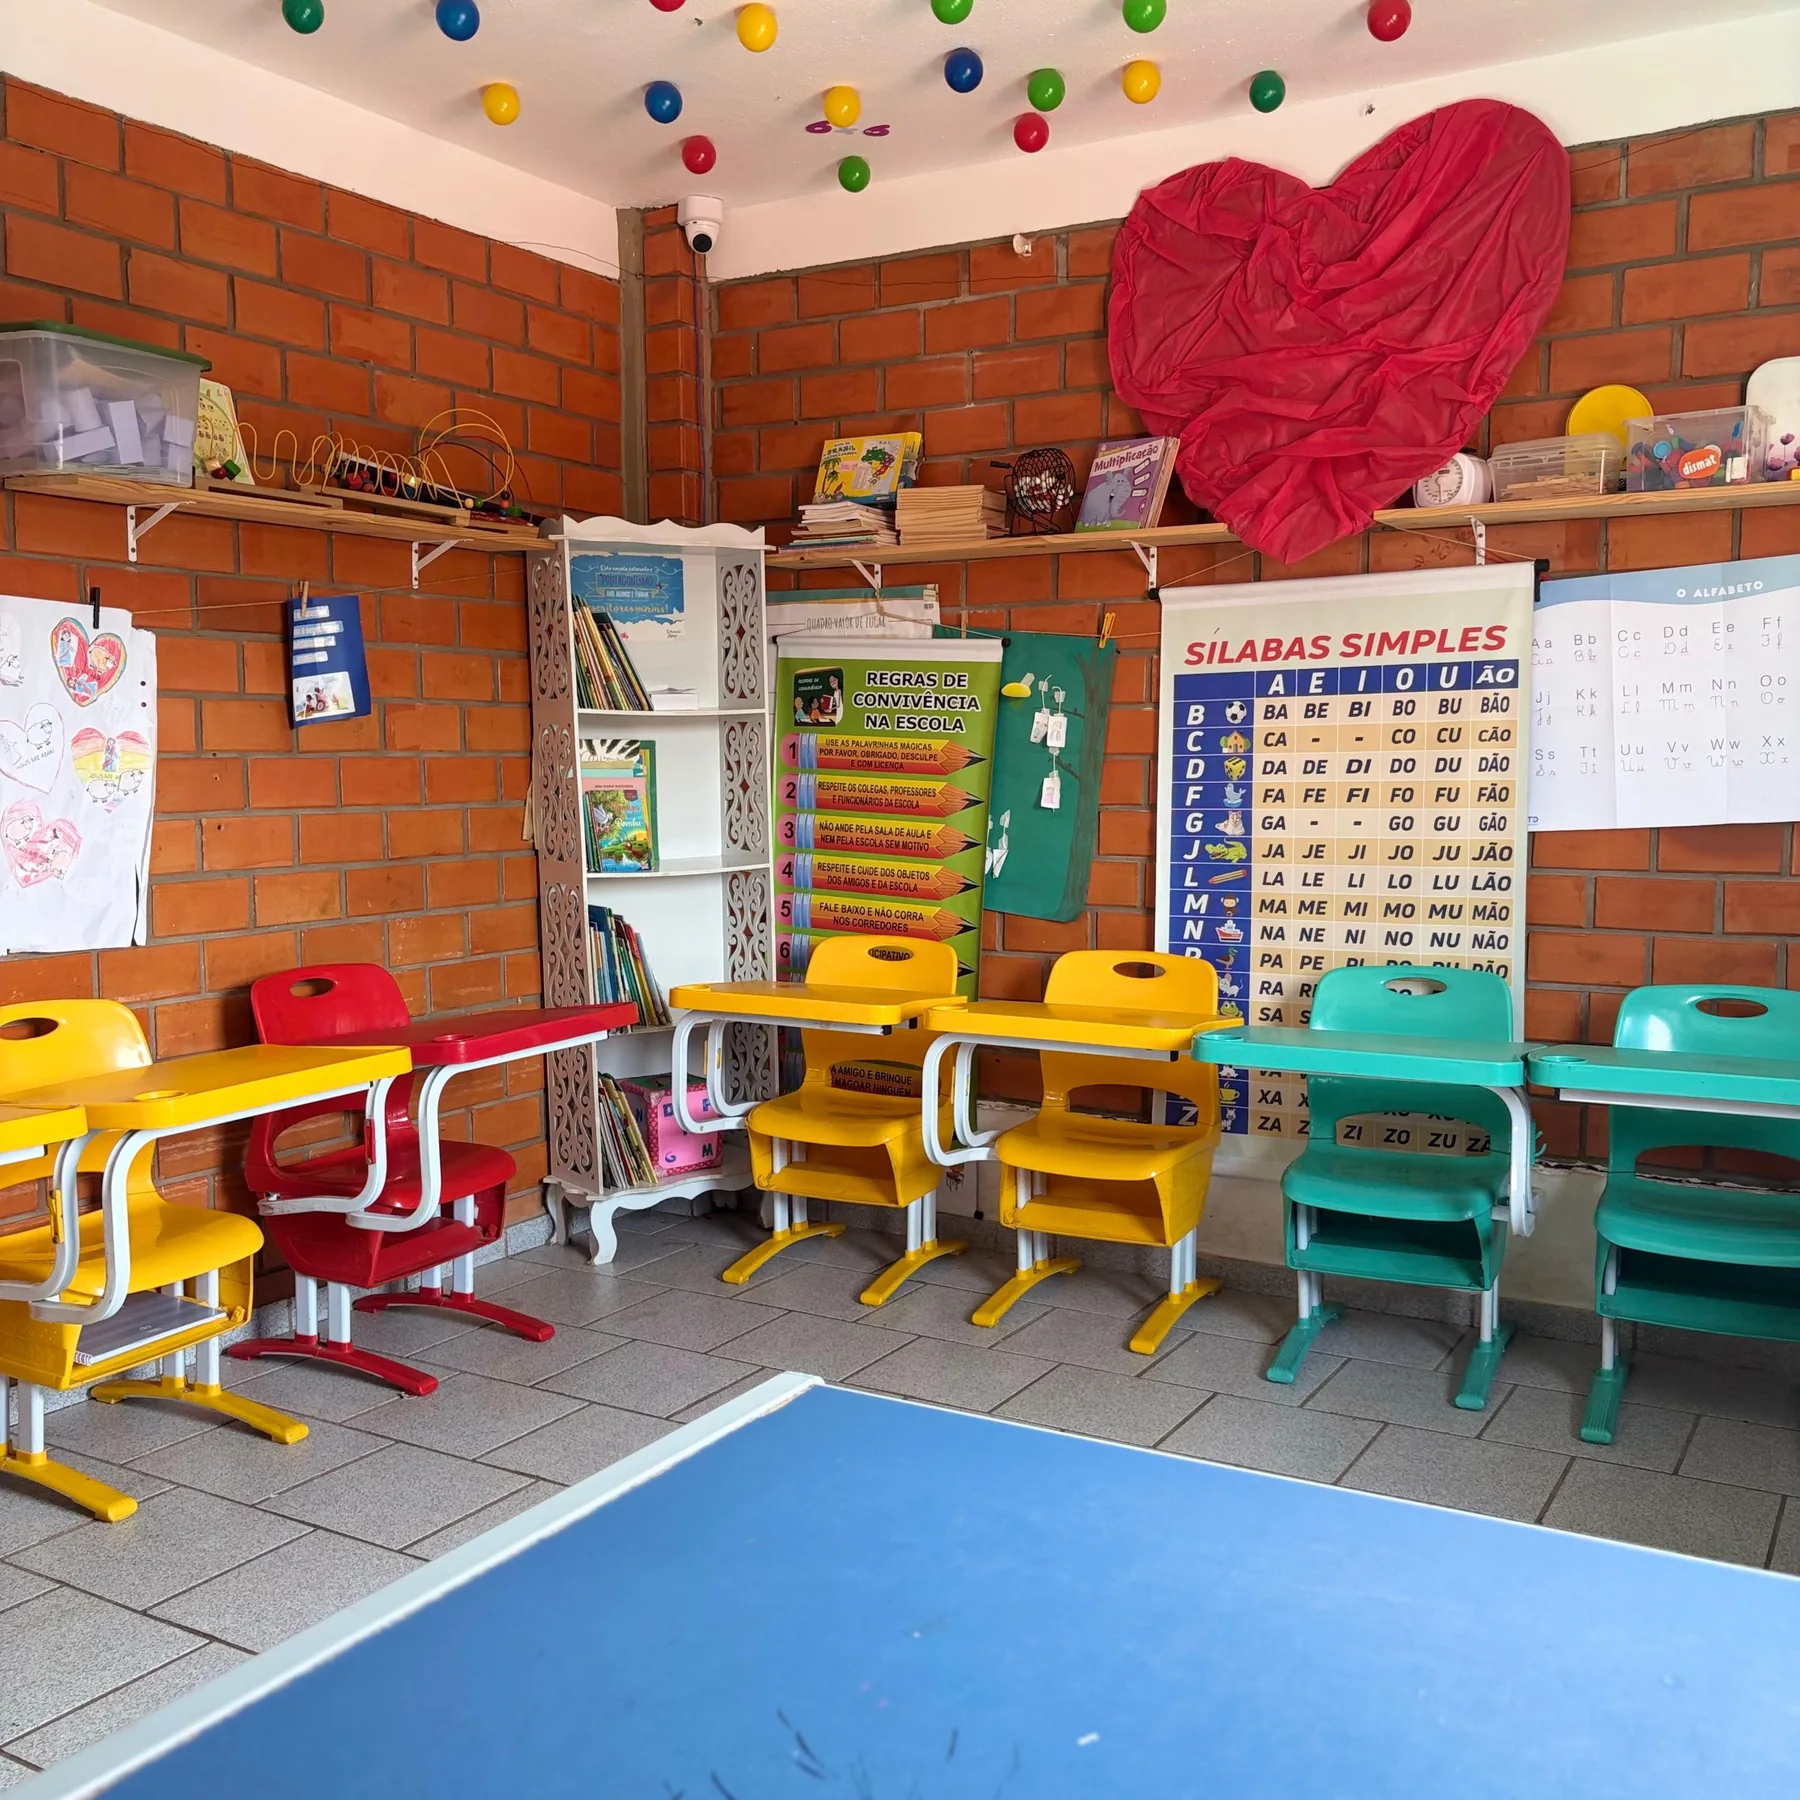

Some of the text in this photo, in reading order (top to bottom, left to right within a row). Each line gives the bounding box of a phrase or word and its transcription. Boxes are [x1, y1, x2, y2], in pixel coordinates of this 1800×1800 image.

[1095, 444, 1159, 472] Multiplicação
[1683, 454, 1717, 475] dismat
[1677, 581, 1763, 598] O ALFABETO
[806, 616, 886, 631] QUADRO VALOR DE LUGAR
[1340, 625, 1507, 658] SIMPLES
[867, 672, 967, 688] REGRAS DE
[1268, 666, 1514, 694] A E I O U ÃO
[853, 691, 980, 710] CONVIVÊNCIA
[1187, 693, 1509, 725] B BA BE BI BO BU BÃO
[866, 715, 965, 731] NA ESCOLA
[851, 740, 898, 749] PALAVRINHAS
[900, 743, 932, 751] MÁGICAS
[1187, 728, 1511, 751] C CA CO CU CÃO
[789, 742, 795, 759] 1
[820, 748, 833, 756] POR
[861, 750, 899, 760] OBRIGADO,
[901, 753, 938, 761] DESCULPE
[873, 761, 904, 772] LICENÇA
[1186, 753, 1509, 778] D DA DE DI DO DU DÃO
[786, 782, 796, 799] 2
[818, 781, 936, 797] RESPEITE OS COLEGAS, PROFESSORES
[1186, 783, 1509, 806] F FA FE FI FO FU FÃO
[833, 795, 919, 809] E FUNCIONÁRIOS DA ESCOLA
[785, 822, 795, 838] 3
[819, 820, 931, 839] NÃO ANDE PELA SALA DE AULA E
[1186, 812, 1507, 832] G GA GO GU GÃO
[821, 835, 929, 851] NEM PELA ESCOLA SEM MOTIVO
[1183, 840, 1512, 861] J JA JE JI JO JU JÃO
[782, 861, 793, 878] 4
[818, 862, 929, 880] RESPEITE E CUIDE DOS OBJETOS
[828, 875, 918, 892] DOS AMIGOS E DA ESCOLA
[1184, 867, 1511, 891] L LA LE LI LO LU LÃO
[781, 900, 791, 917] 5
[820, 902, 924, 921] FALE BAIXO E NÃO CORRA
[1184, 894, 1509, 921] M MA ME MI MO MU MÃO
[833, 916, 908, 932] NOS CORREDORES
[780, 942, 792, 961] 6
[838, 1066, 865, 1078] AMIGO
[868, 1070, 872, 1078] E
[875, 1072, 912, 1085] BRINQUE
[834, 1079, 870, 1090] MAGOAR
[1343, 1125, 1457, 1148] ZI ZO ZU
[702, 1143, 713, 1157] M
